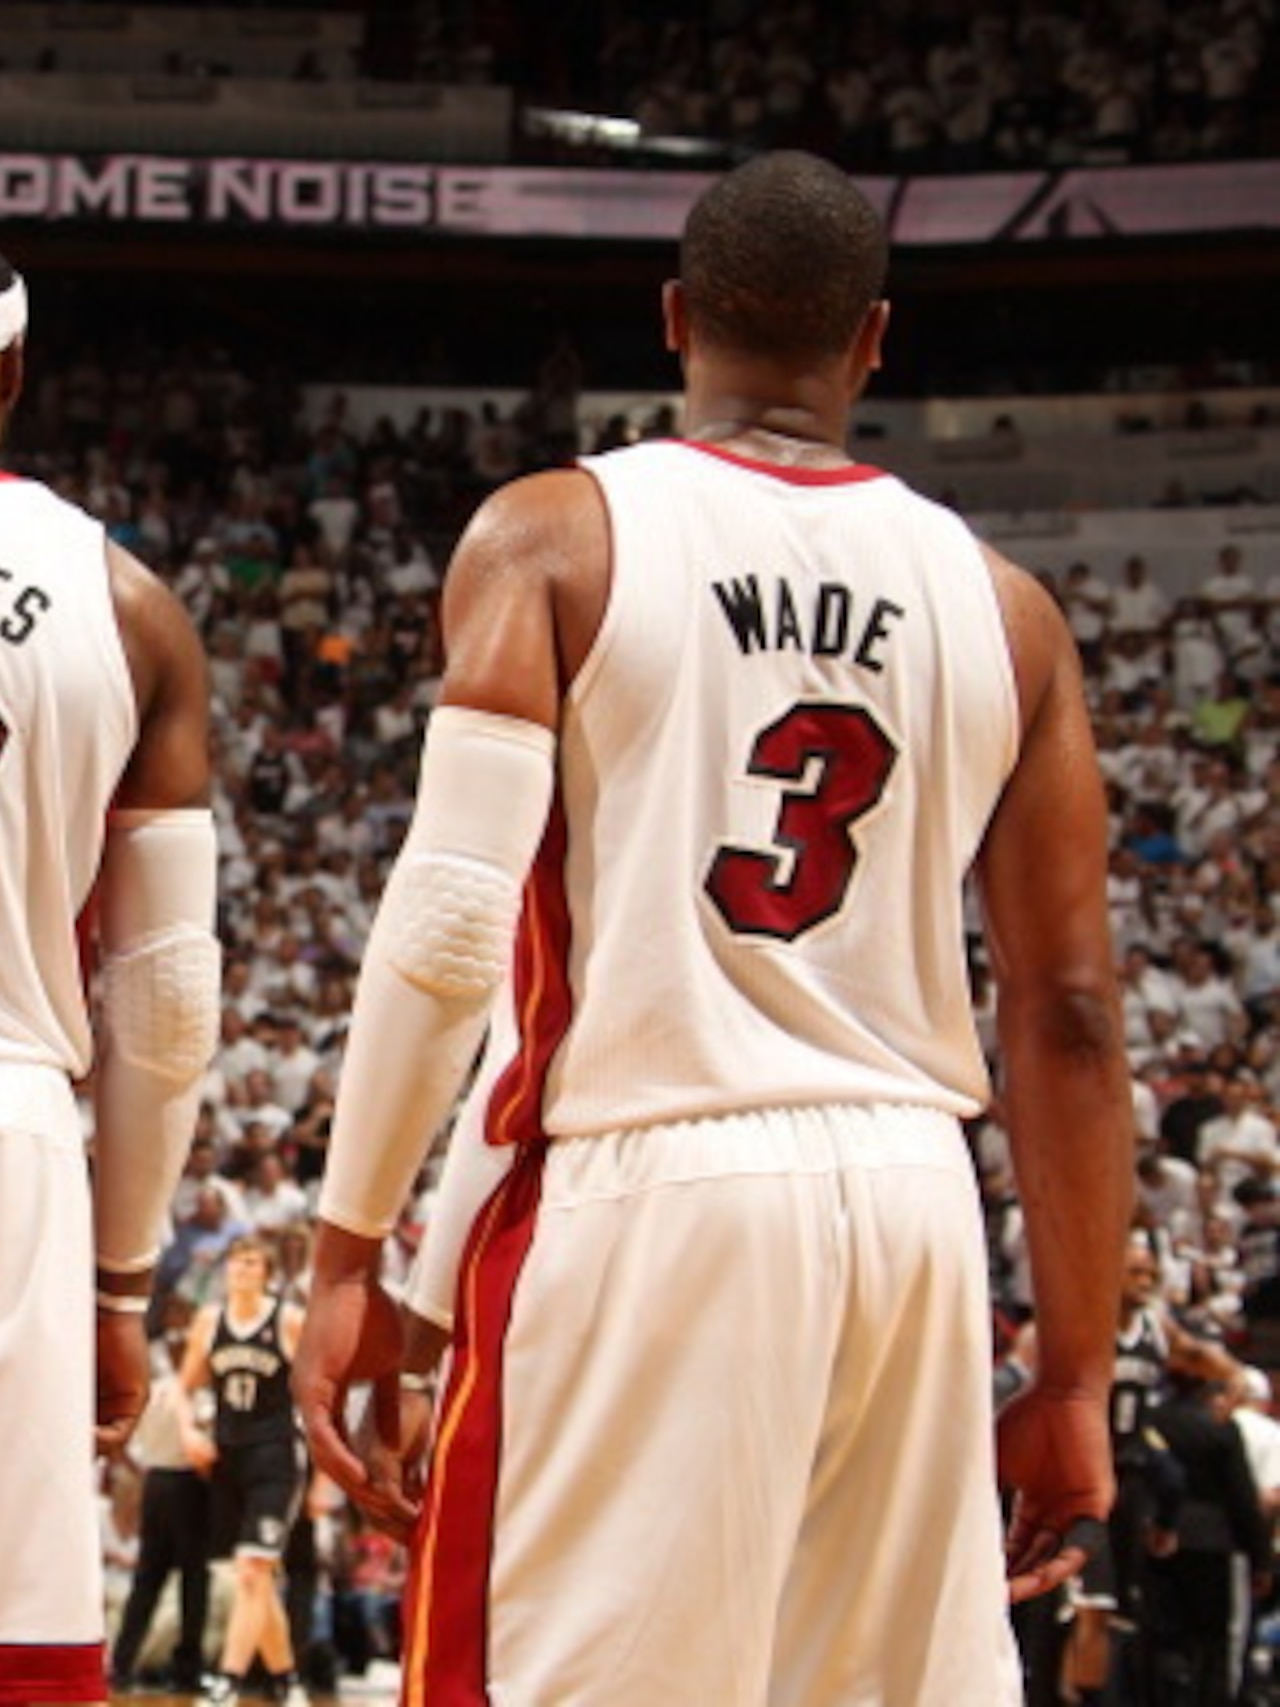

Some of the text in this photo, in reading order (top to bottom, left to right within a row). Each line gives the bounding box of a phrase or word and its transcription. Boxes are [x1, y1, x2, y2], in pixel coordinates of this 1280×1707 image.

[207, 161, 487, 226] NOISE
[712, 574, 905, 673] WADE
[704, 702, 900, 943] 3
